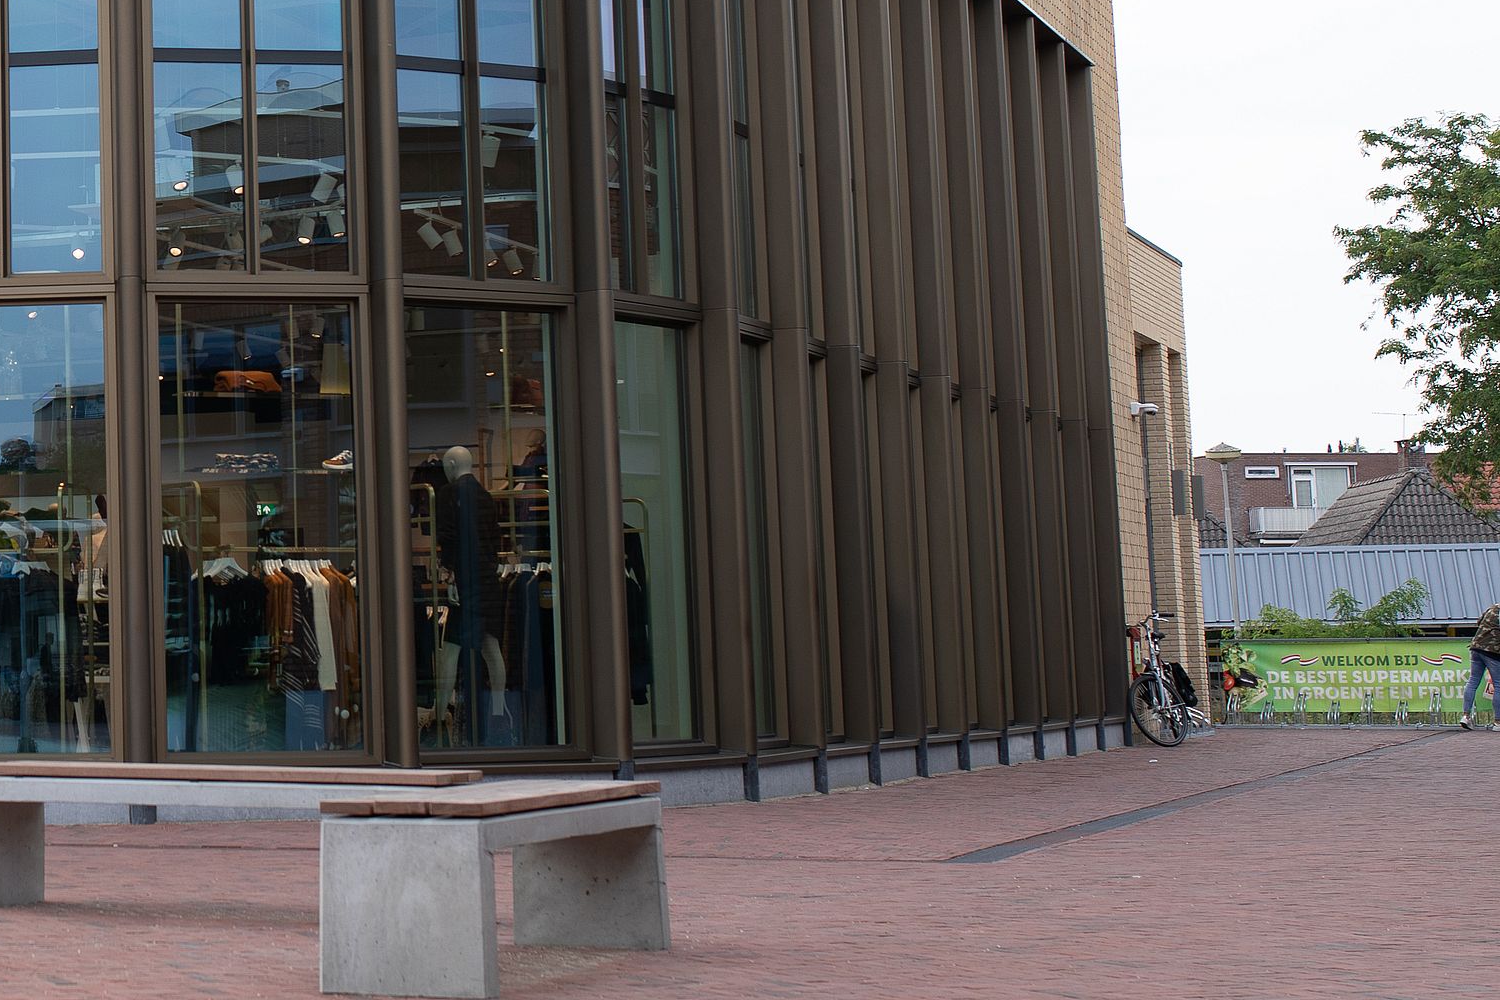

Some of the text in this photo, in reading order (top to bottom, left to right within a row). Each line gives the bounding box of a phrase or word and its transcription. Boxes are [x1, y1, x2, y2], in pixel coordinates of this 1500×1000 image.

[1321, 654, 1419, 667] WELKOM BIJ
[1266, 669, 1471, 684] DE BESTE SUPERMARK
[1273, 686, 1295, 700] IN
[1298, 686, 1384, 700] GROENTE
[1389, 686, 1413, 700] EN
